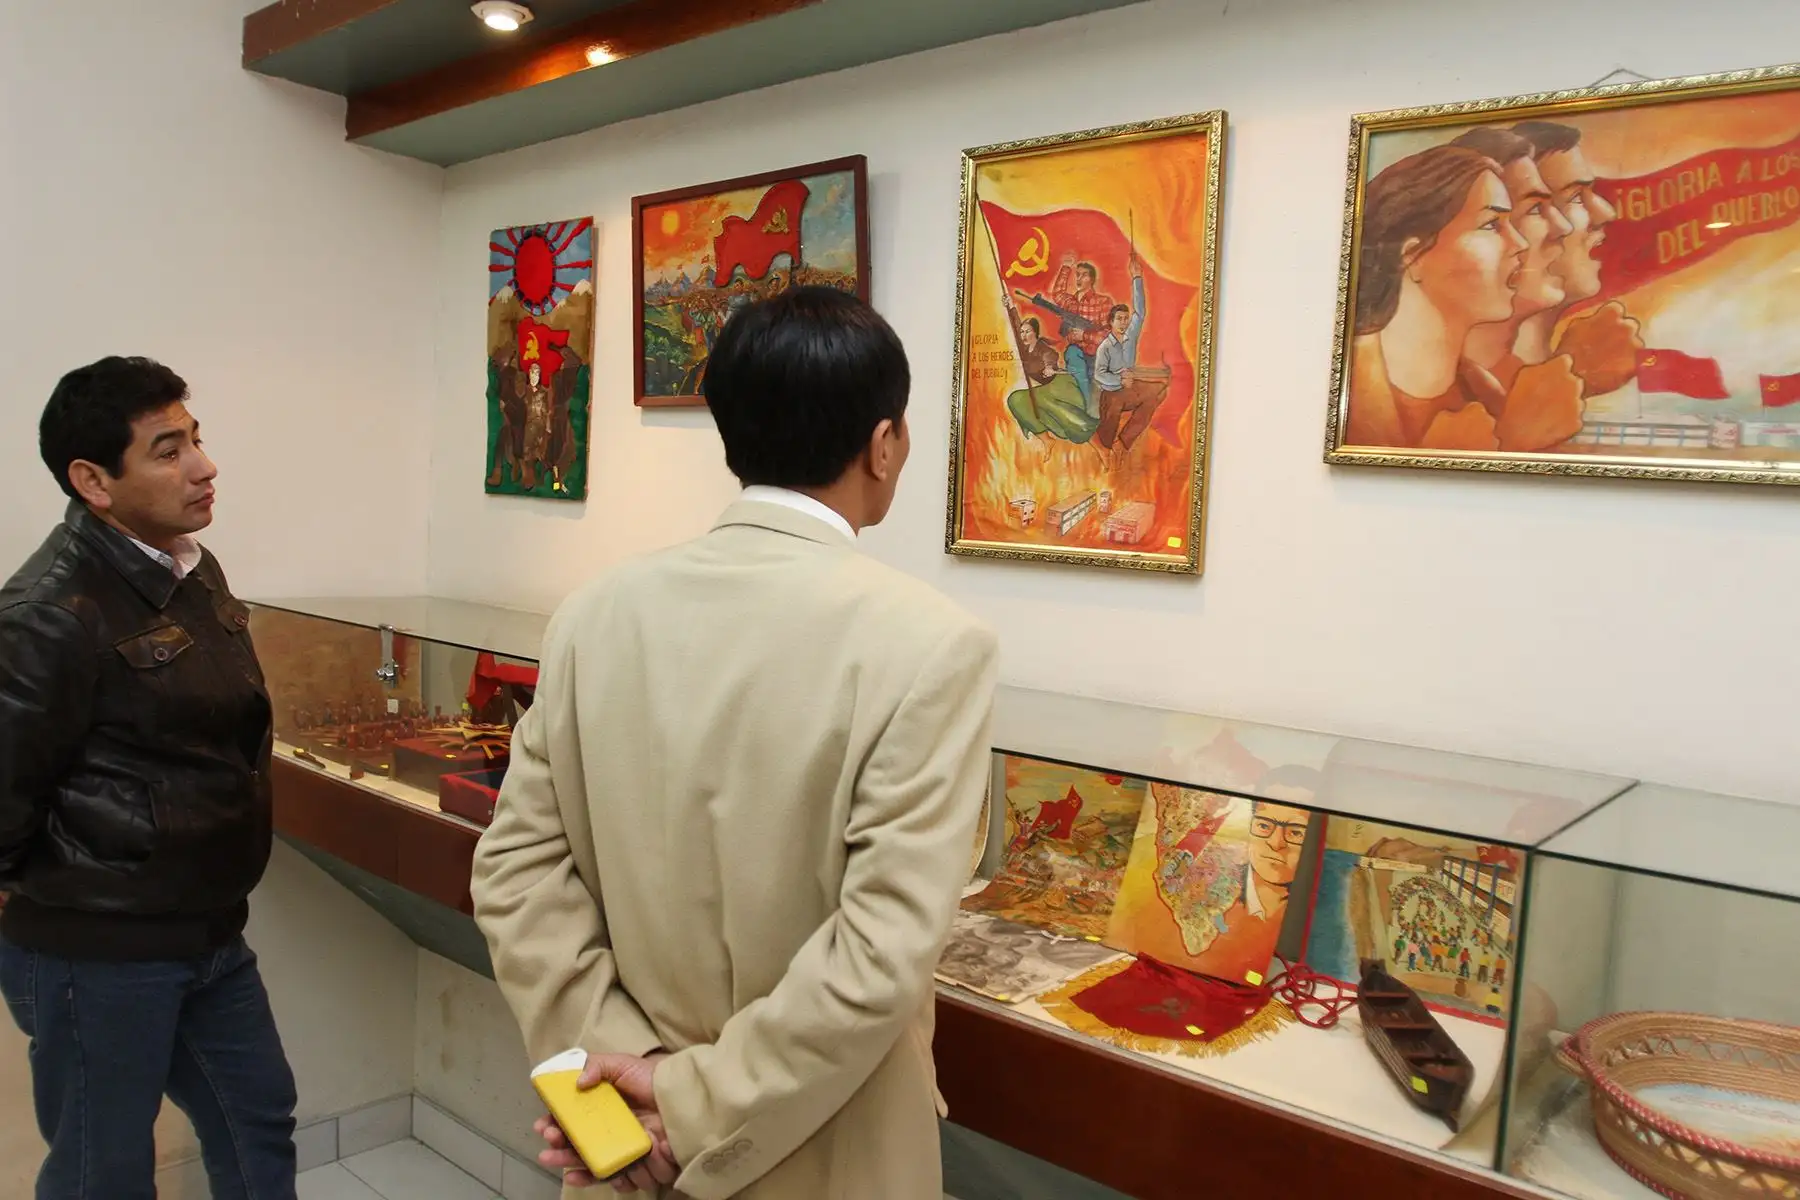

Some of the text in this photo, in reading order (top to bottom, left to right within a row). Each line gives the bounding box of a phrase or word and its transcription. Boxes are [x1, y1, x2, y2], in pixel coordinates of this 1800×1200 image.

[1736, 157, 1753, 184] A
[1656, 186, 1799, 264] DEL PUEBLO
